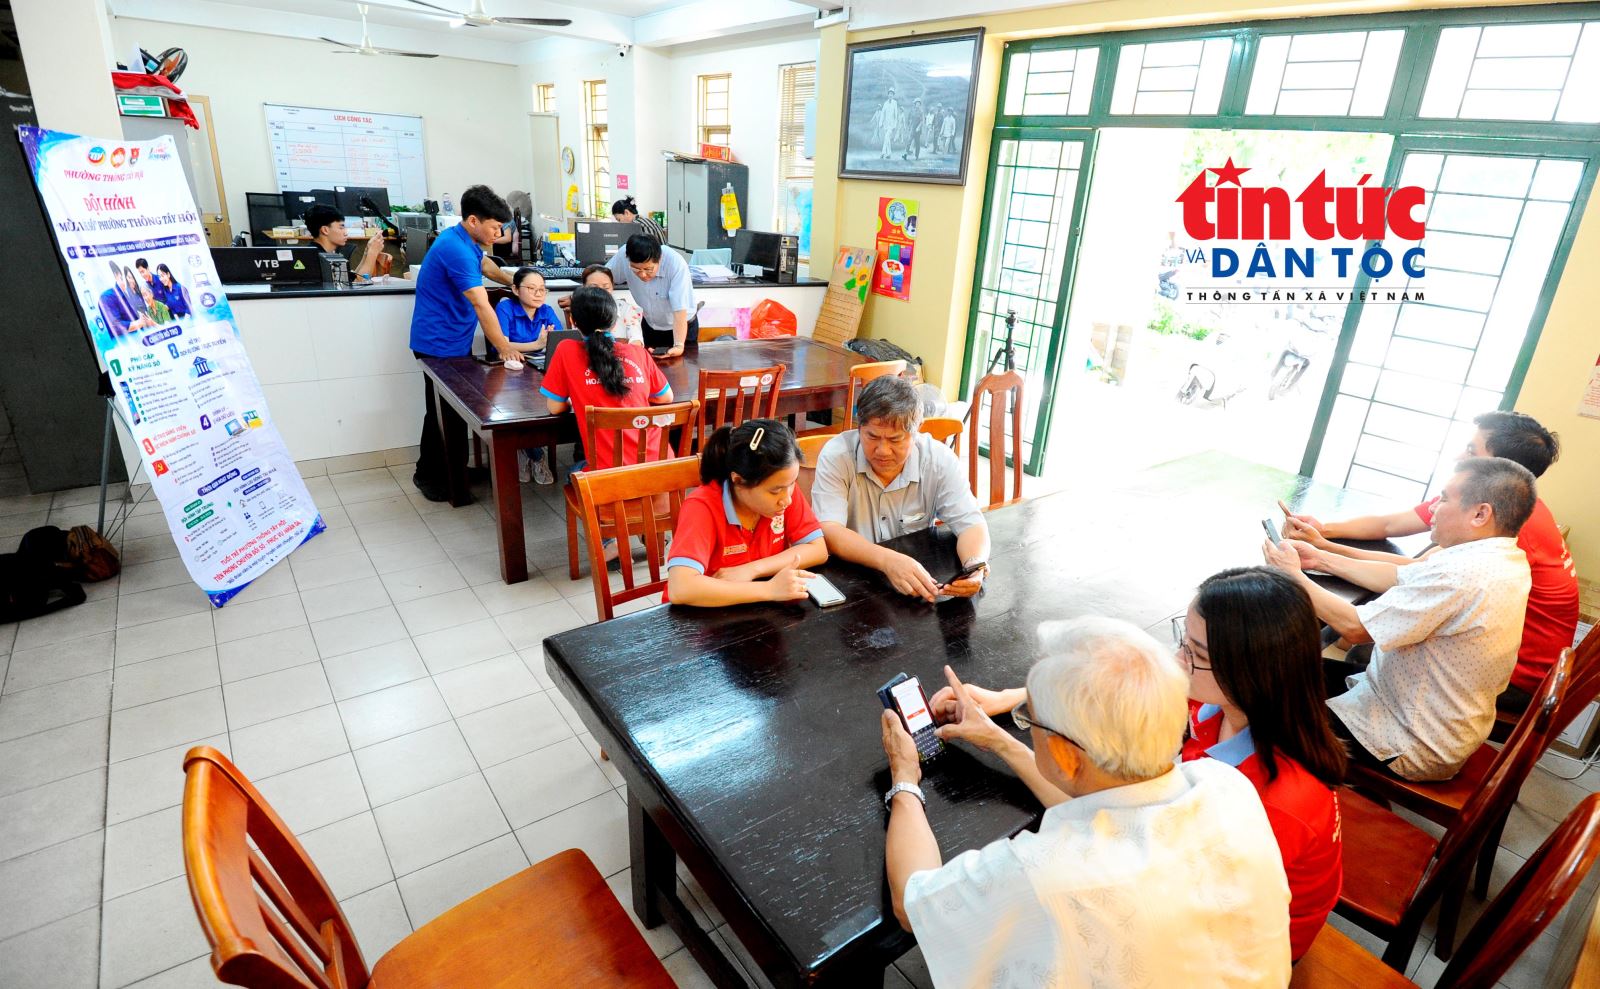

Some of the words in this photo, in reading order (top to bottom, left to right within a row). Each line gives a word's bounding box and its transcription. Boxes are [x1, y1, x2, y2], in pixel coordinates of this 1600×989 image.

[83, 194, 102, 216] ĐỘI
[104, 194, 136, 210] HÌNH
[98, 217, 127, 230] PHƯỜNG
[127, 214, 162, 228] THÔNG
[162, 212, 176, 224] TÂY
[178, 210, 197, 222] HỘI
[254, 260, 280, 268] VTB
